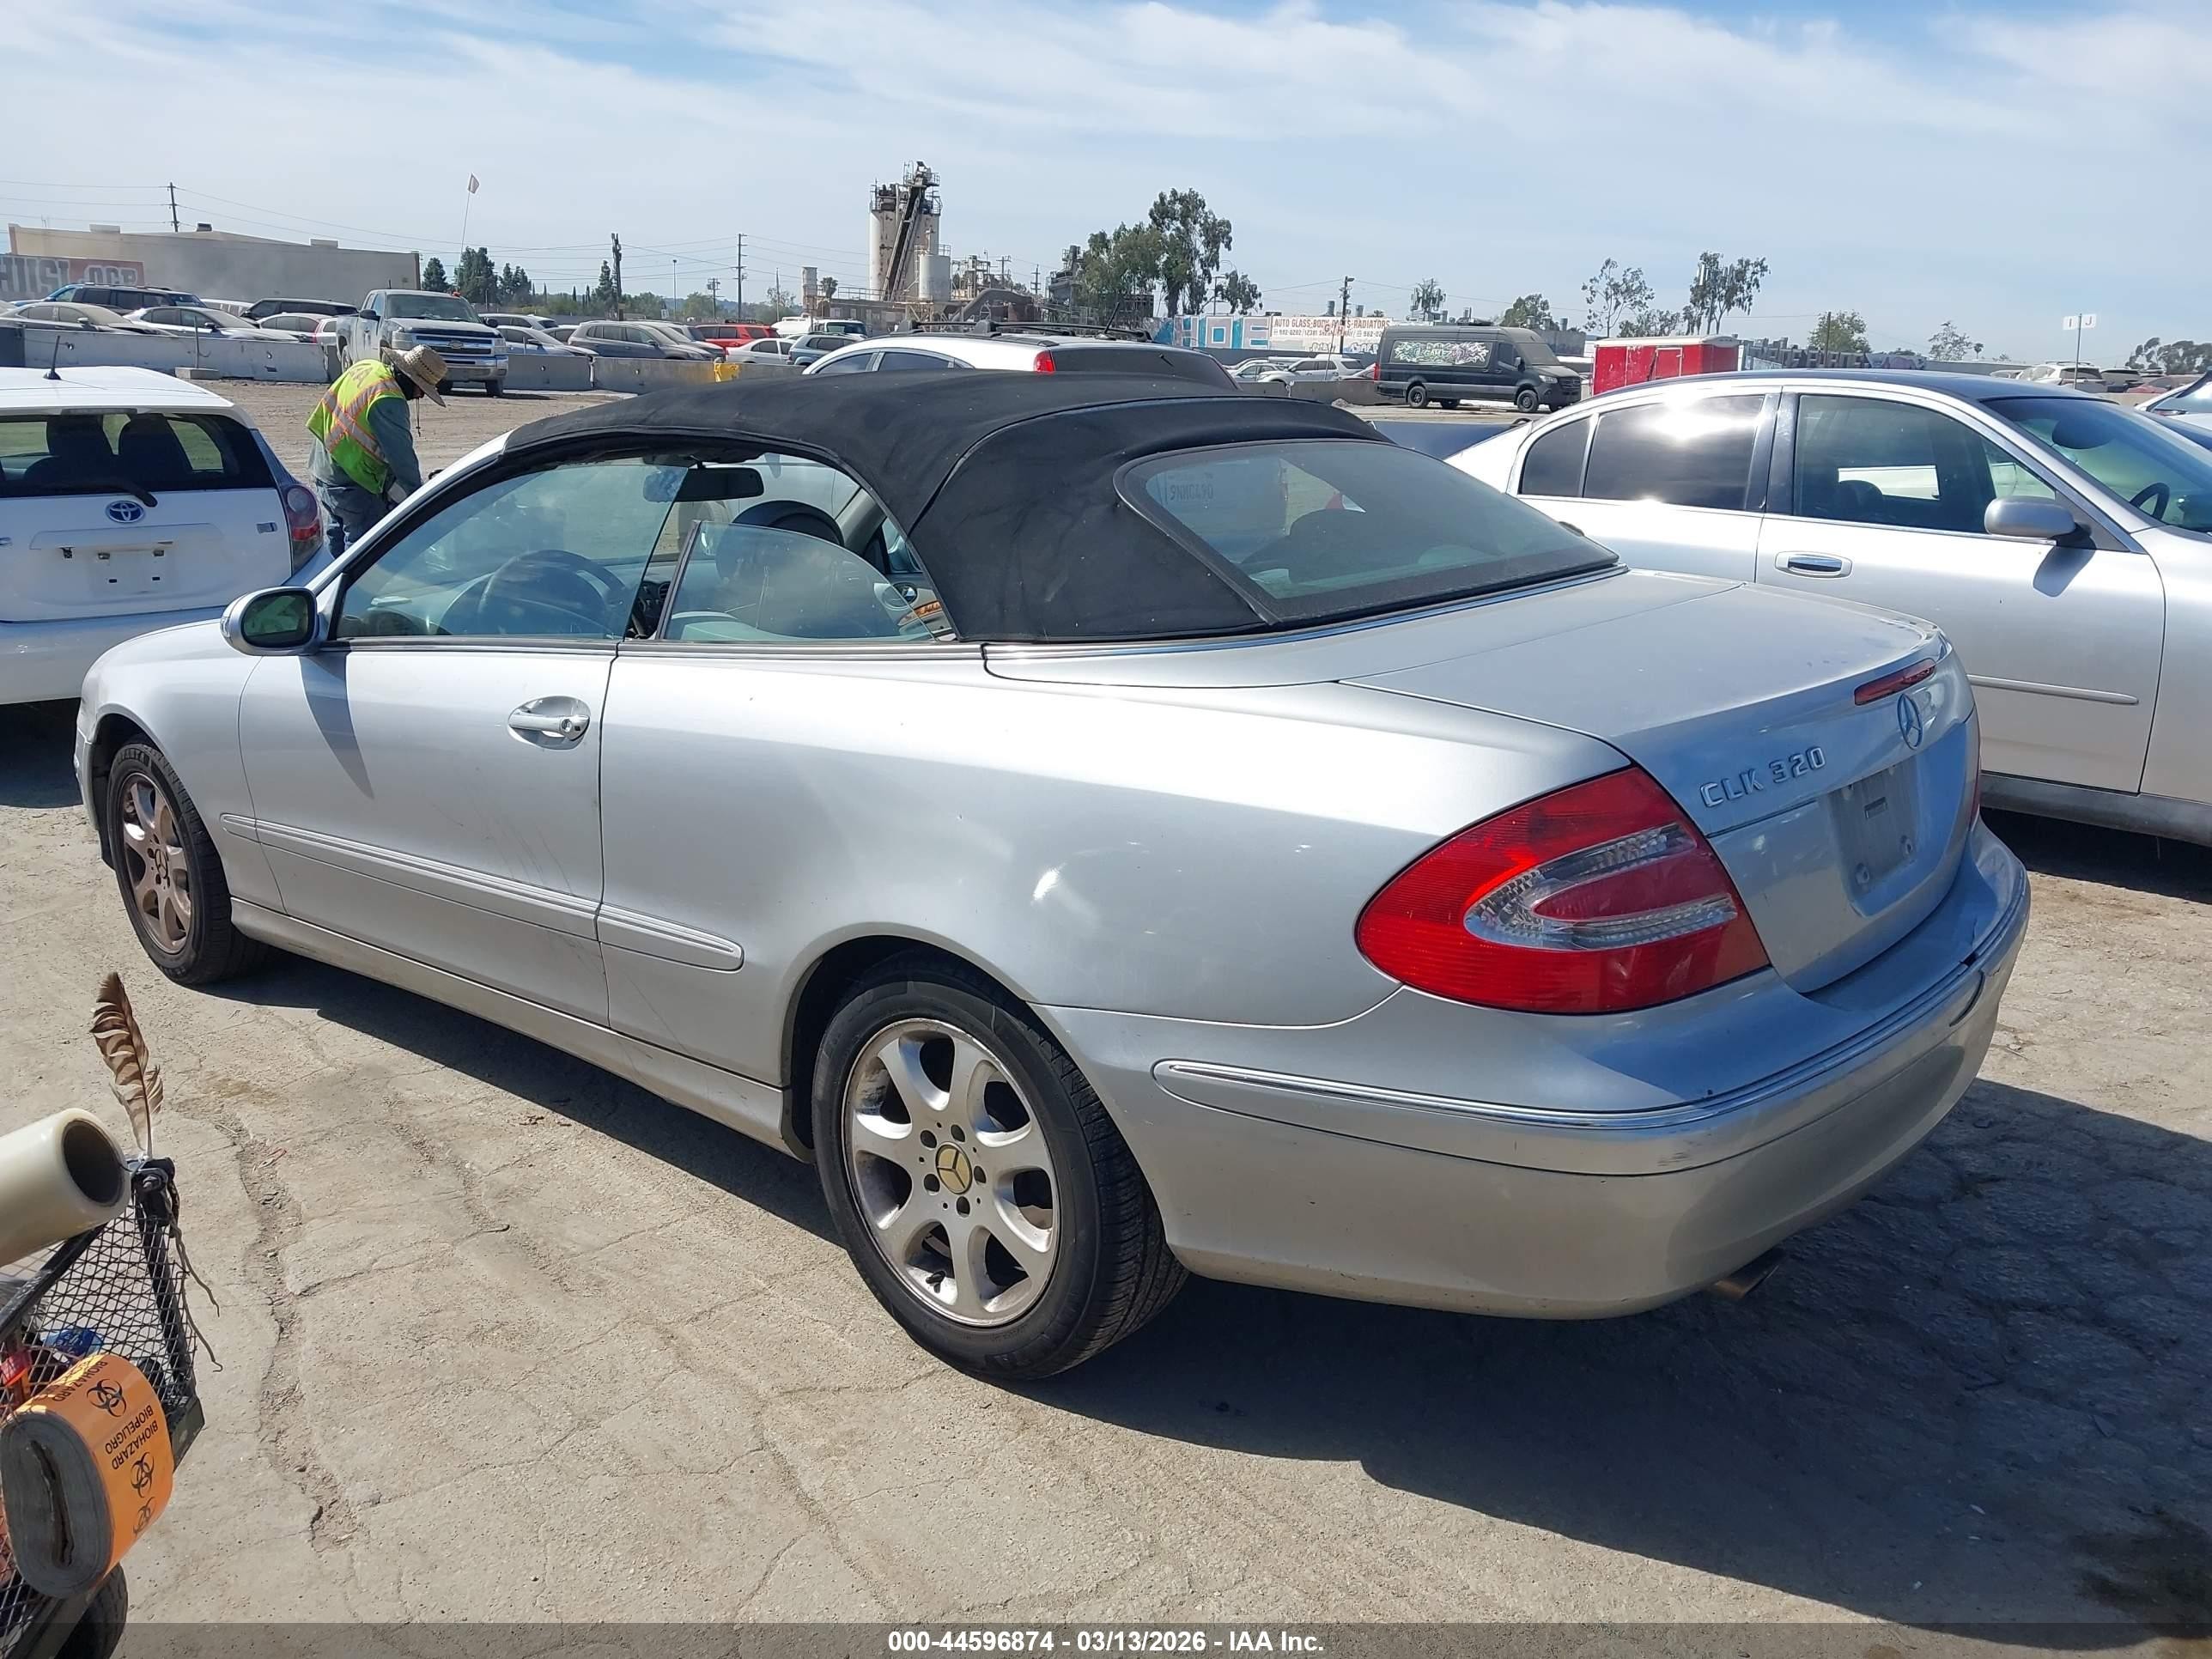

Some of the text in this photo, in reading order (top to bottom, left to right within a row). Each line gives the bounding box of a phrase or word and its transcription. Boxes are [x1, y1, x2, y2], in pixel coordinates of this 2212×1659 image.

[1273, 319, 1290, 328] AUTO
[2085, 316, 2093, 325] J
[1700, 747, 1826, 808] CLK 320
[52, 1360, 108, 1402] BIOHAZARD
[105, 1405, 153, 1455] BIOPELIGRO
[112, 1421, 159, 1470] BIOHAZARD
